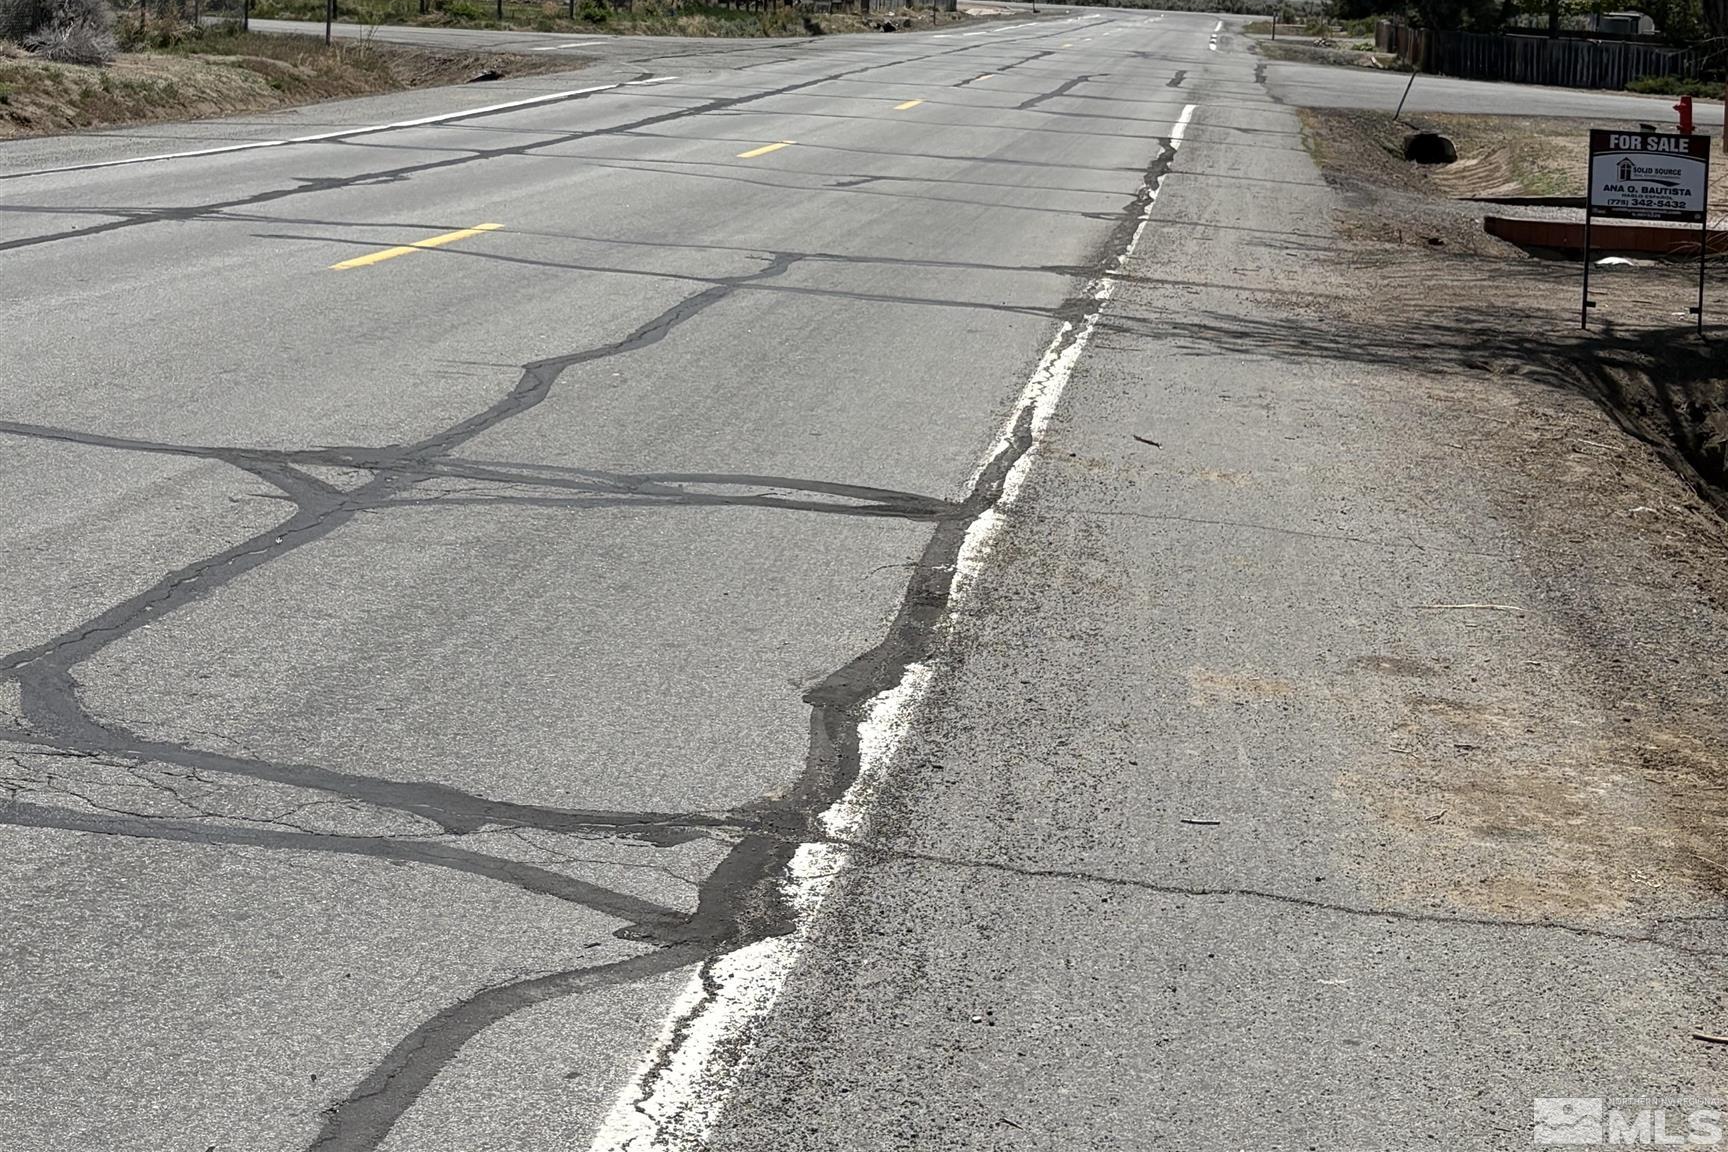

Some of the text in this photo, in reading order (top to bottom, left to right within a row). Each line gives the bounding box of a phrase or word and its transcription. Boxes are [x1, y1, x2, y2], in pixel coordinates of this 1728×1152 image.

[1609, 135, 1689, 152] FOR SALE
[1655, 168, 1682, 176] SOURCE
[1603, 184, 1625, 193] ANA
[1641, 186, 1692, 196] BAUTISTA
[1631, 199, 1687, 208] 342-5432
